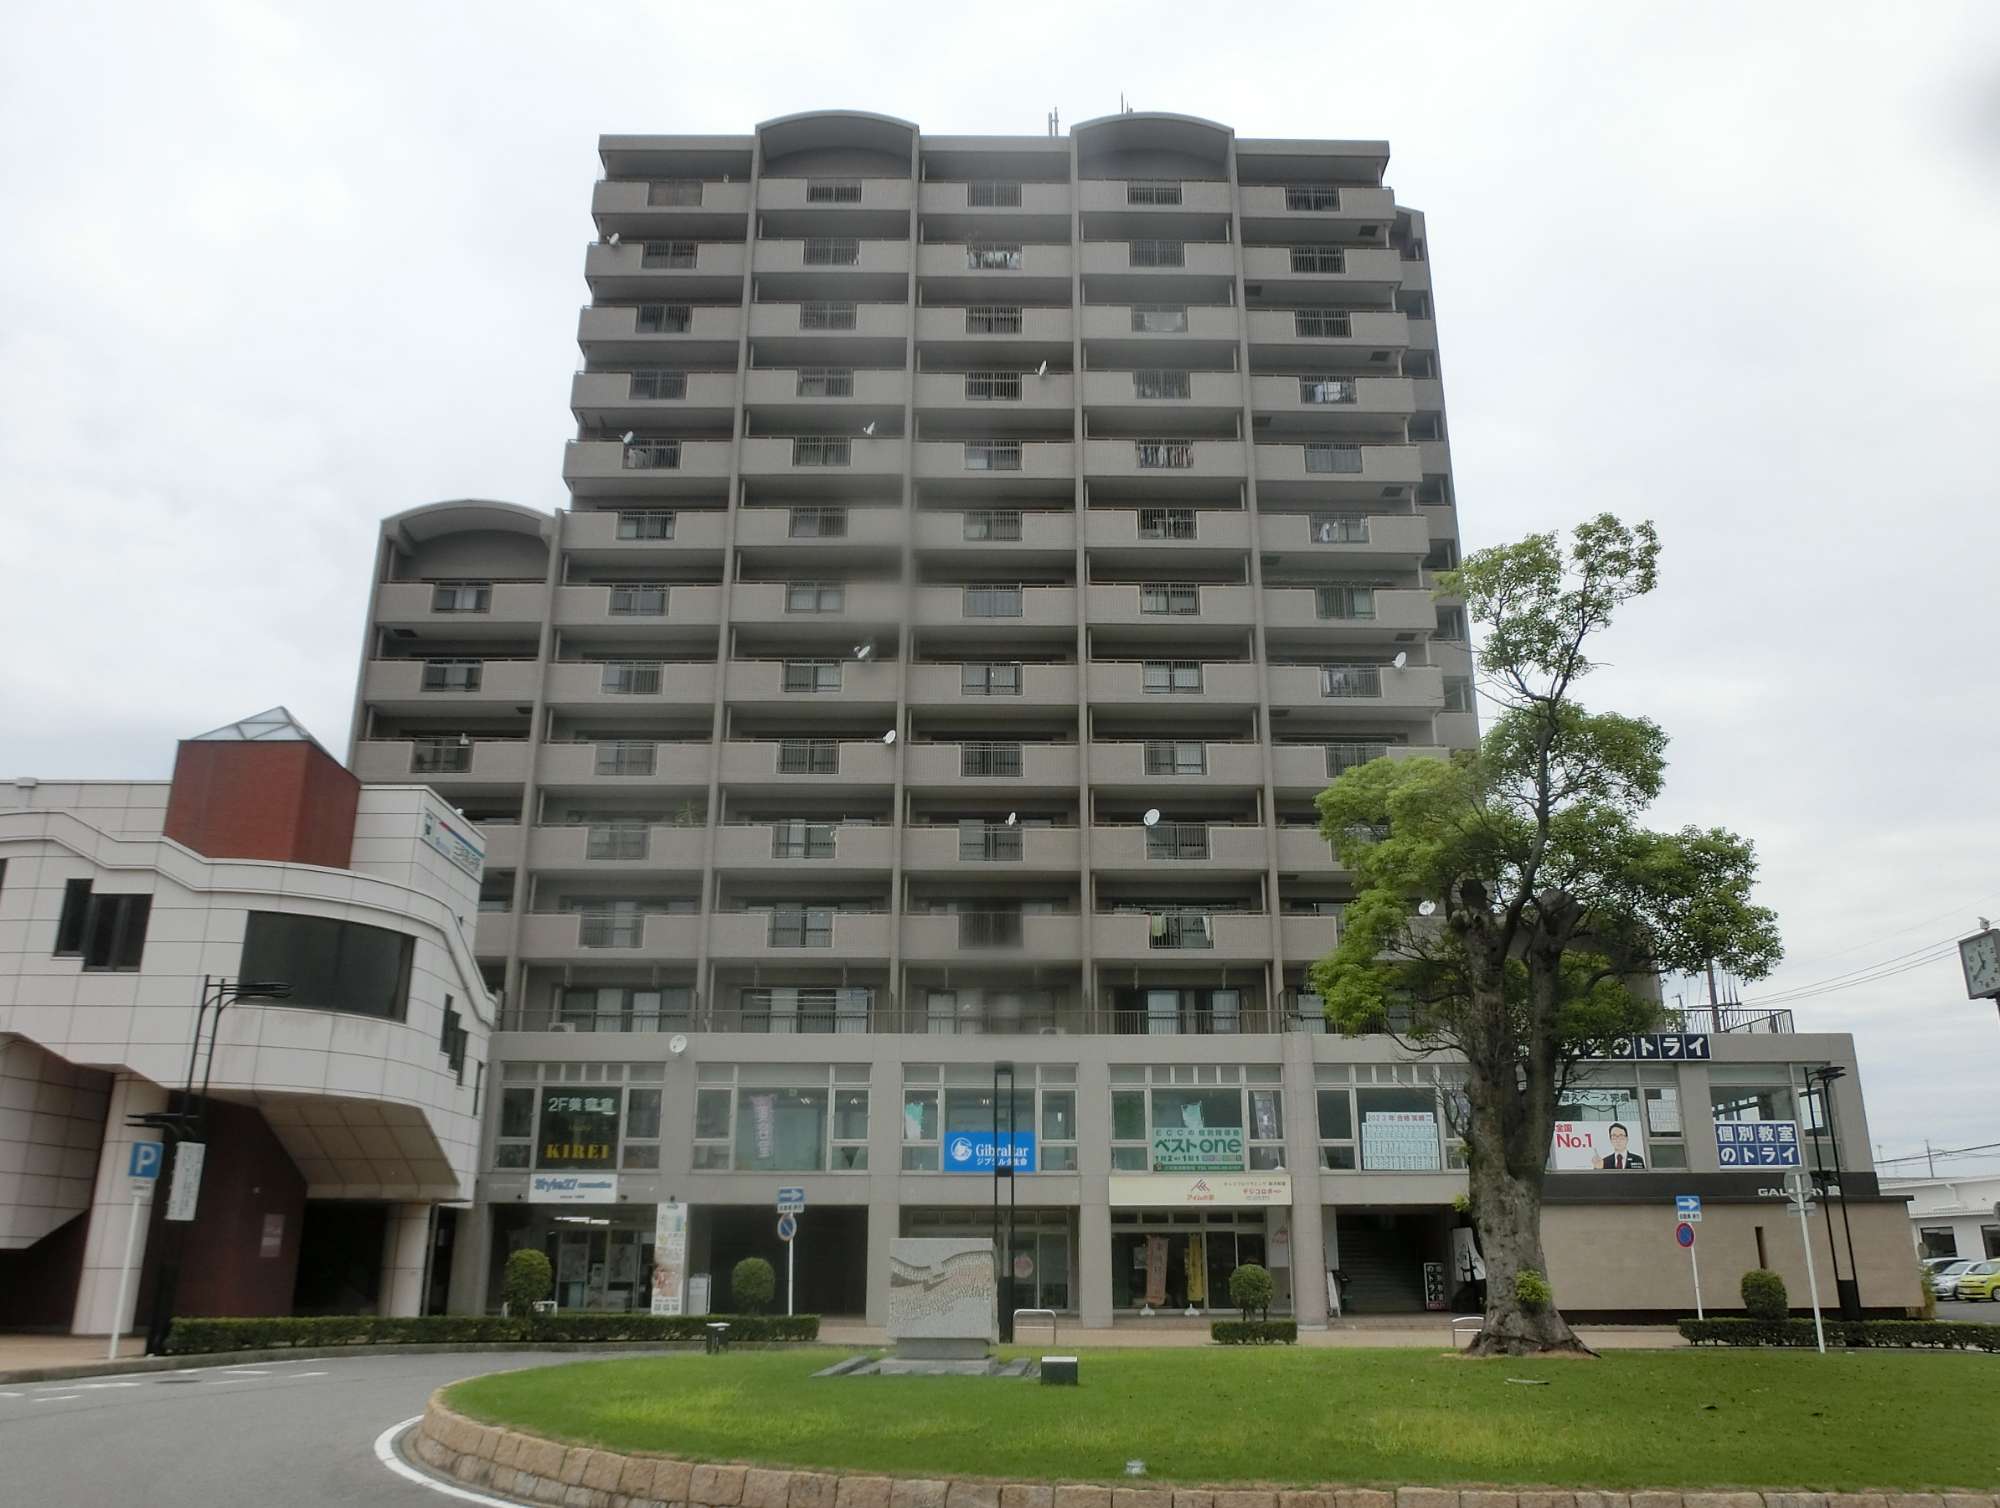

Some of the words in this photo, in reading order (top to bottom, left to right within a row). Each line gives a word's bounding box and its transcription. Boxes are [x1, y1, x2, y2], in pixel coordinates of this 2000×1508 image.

[1556, 1124, 1572, 1133] 全国
[1718, 1126, 1795, 1142] 個別教室
[1556, 1133, 1592, 1148] No.1
[545, 1144, 609, 1159] KIREI
[1721, 1147, 1795, 1163] のトライ
[136, 1145, 157, 1174] P
[1758, 1188, 1824, 1197] GALRY
